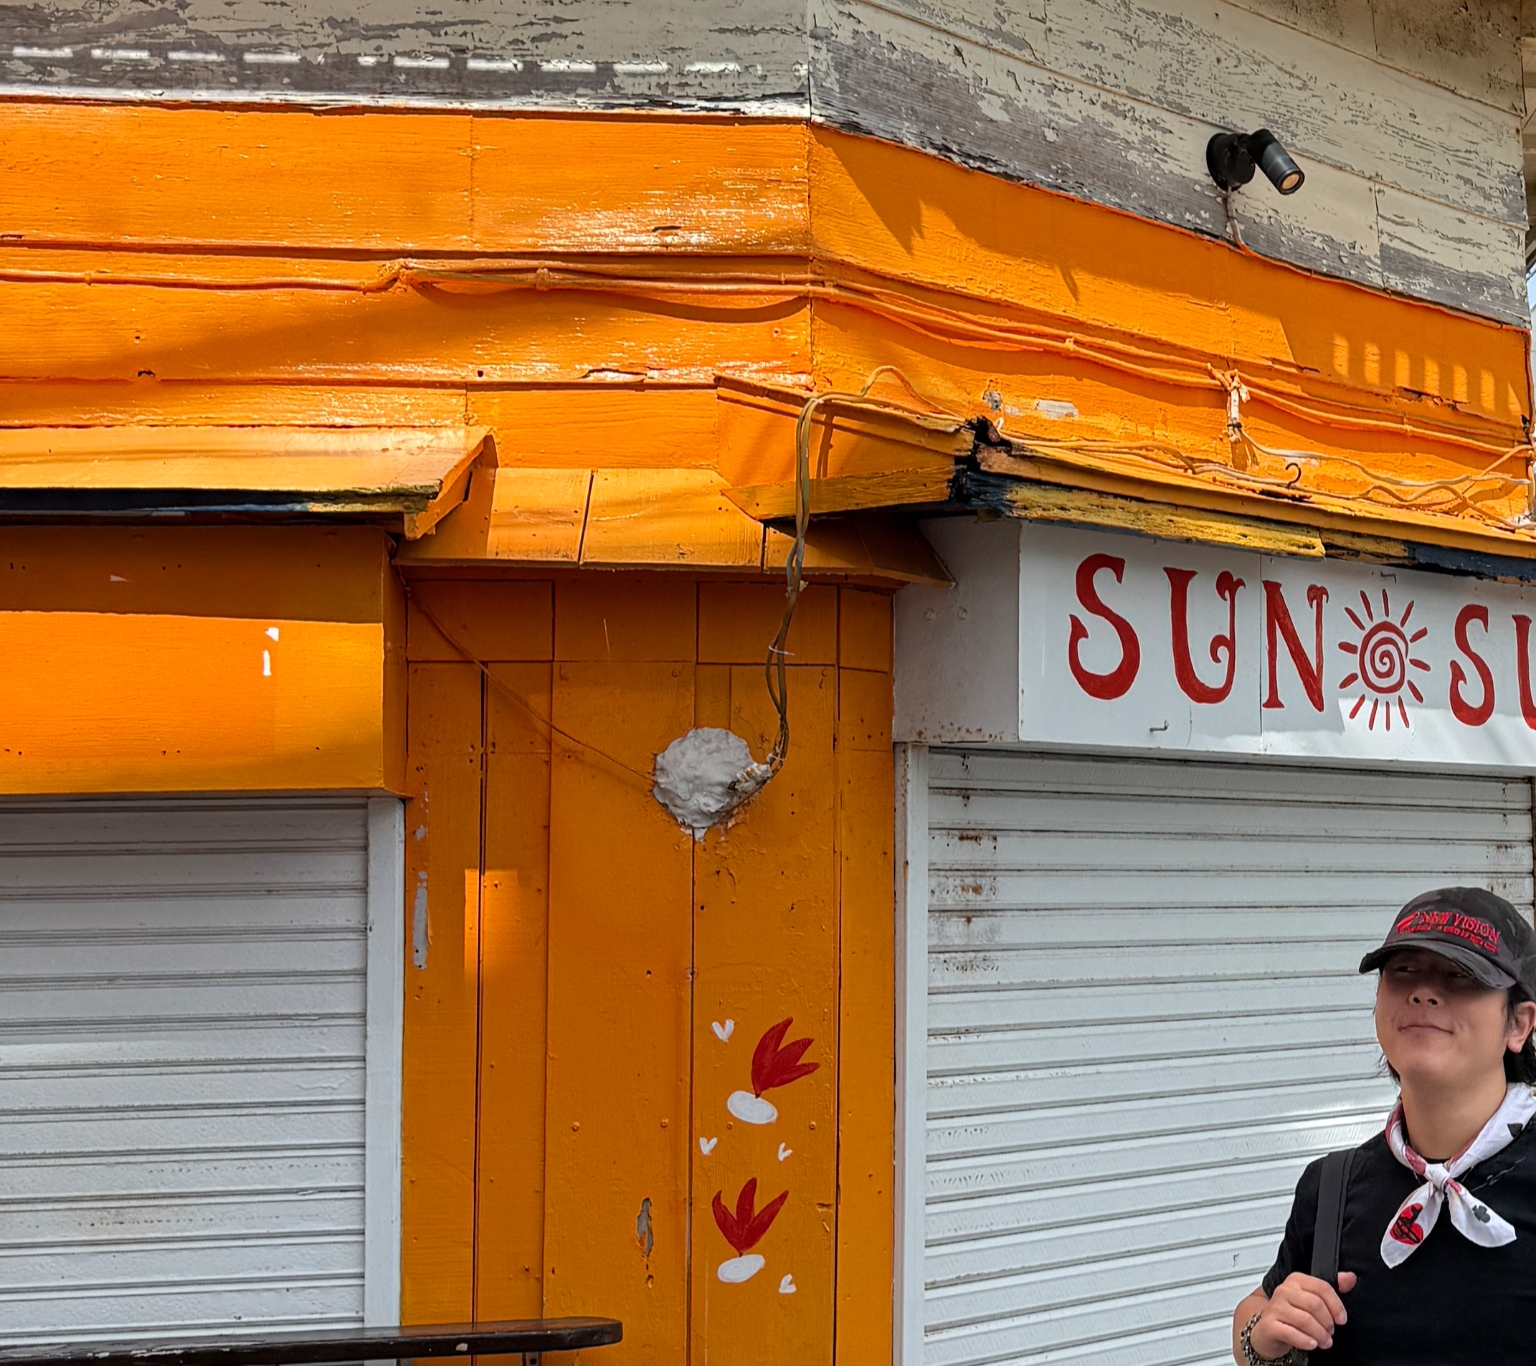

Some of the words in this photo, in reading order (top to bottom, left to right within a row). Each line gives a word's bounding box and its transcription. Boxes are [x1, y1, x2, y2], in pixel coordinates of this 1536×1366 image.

[1068, 552, 1329, 713] SUN
[1419, 911, 1453, 925] NEW
[1453, 913, 1501, 944] VISION
